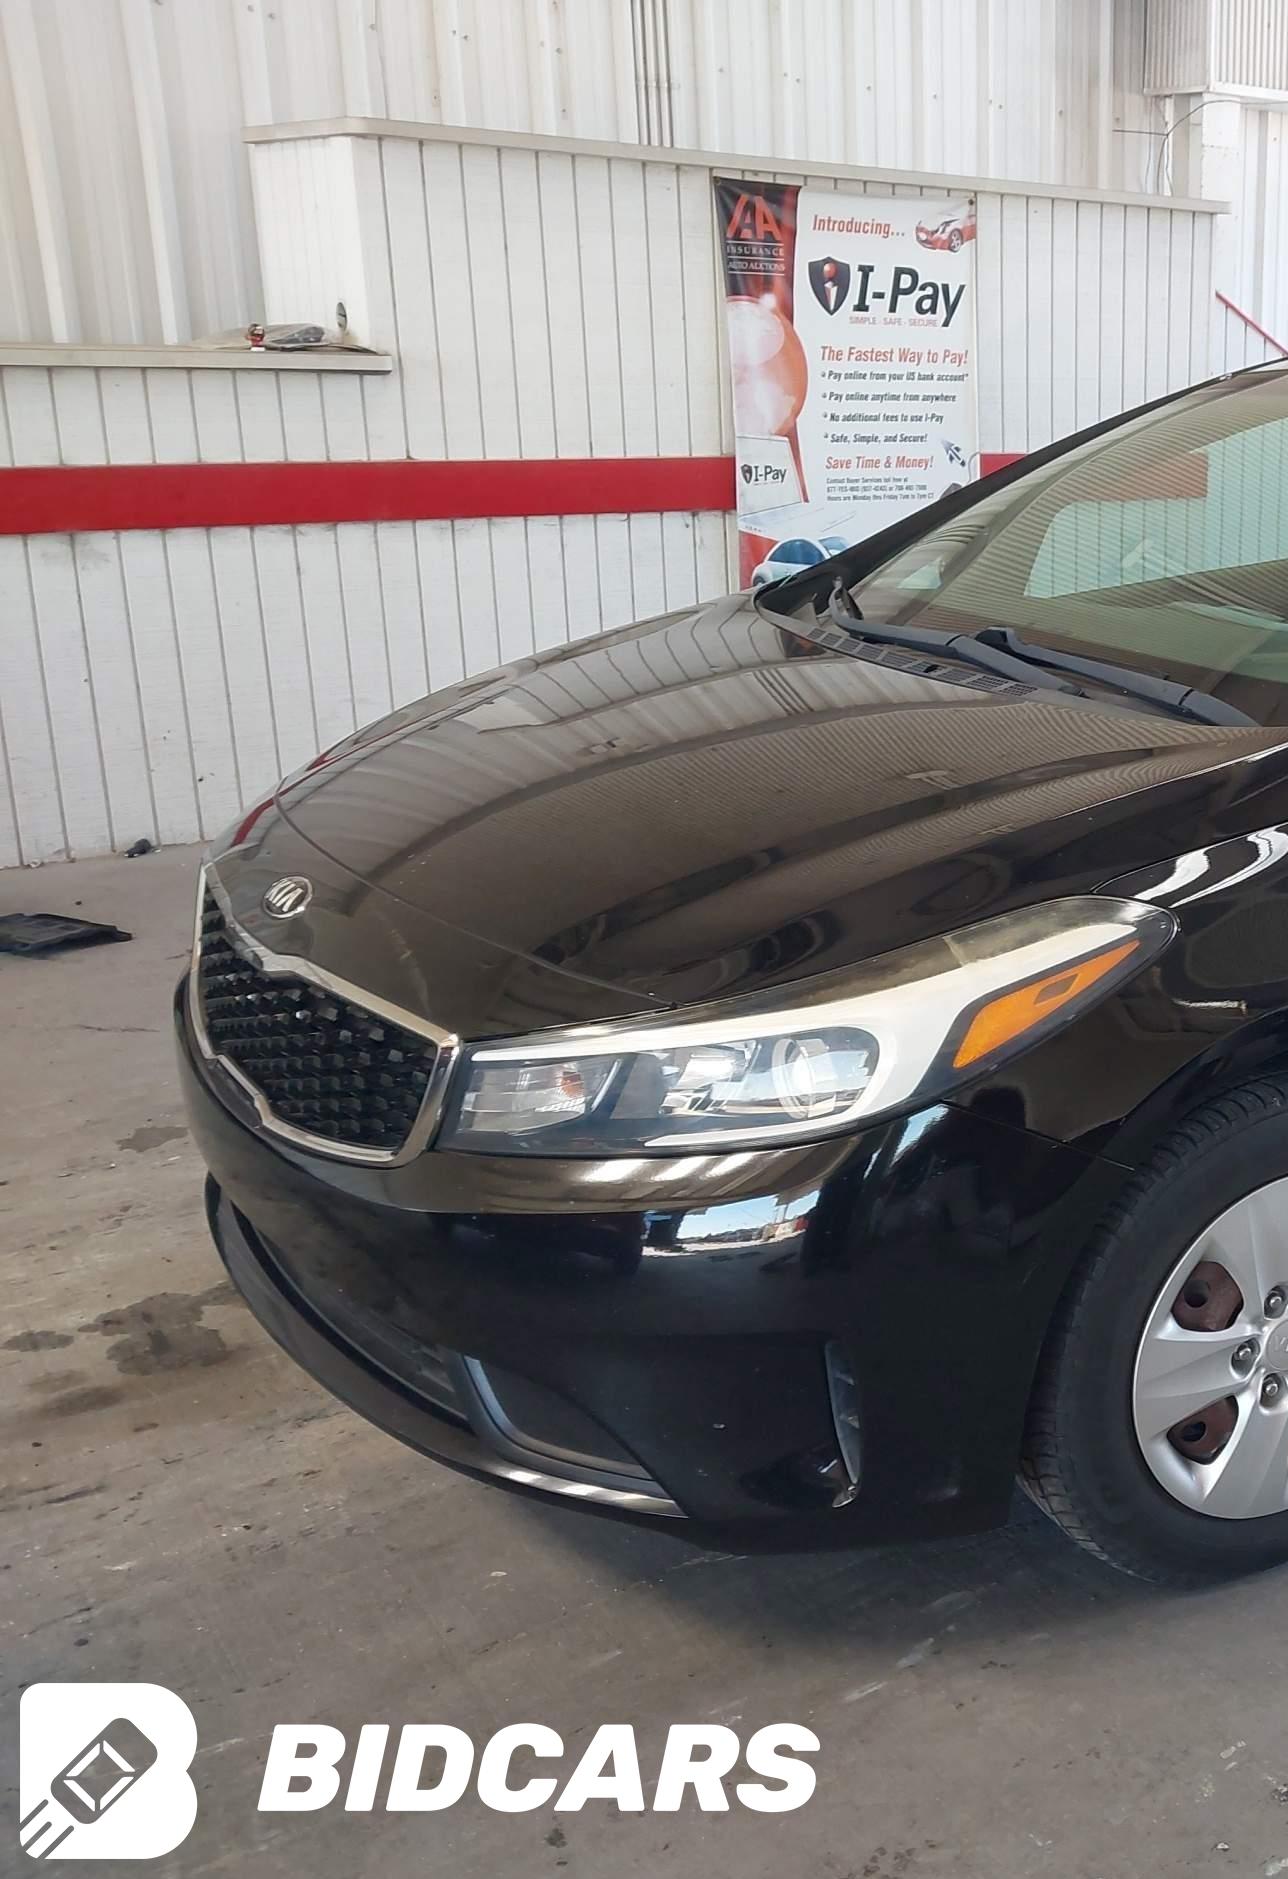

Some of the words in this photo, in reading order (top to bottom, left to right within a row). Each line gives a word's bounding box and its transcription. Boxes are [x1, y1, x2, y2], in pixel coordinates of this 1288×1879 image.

[812, 214, 905, 239] Introducing...
[726, 244, 784, 256] INSURANCE
[727, 261, 748, 270] AUTO
[748, 261, 786, 272] AUCTIONS
[852, 264, 967, 328] I-Pay
[820, 345, 843, 362] The
[847, 346, 894, 363] Fastest
[898, 347, 924, 367] Way
[926, 348, 939, 364] to
[942, 349, 969, 368] Pay!
[827, 370, 843, 383] Pay
[844, 370, 867, 381] online
[869, 371, 887, 381] from
[888, 373, 905, 383] your
[905, 372, 916, 381] US
[917, 372, 934, 382] bank
[828, 391, 843, 403] Pay
[845, 392, 869, 402] online
[871, 392, 901, 404] anytime
[903, 392, 921, 402] from
[921, 393, 957, 404] anywhere
[829, 412, 840, 422] No
[841, 412, 881, 423] additional
[882, 413, 899, 423] fees
[900, 413, 909, 422] to
[910, 414, 923, 423] use
[924, 412, 944, 424] I-Pay
[830, 433, 851, 444] Safe,
[853, 433, 881, 445] Simple,
[883, 433, 898, 443] and
[899, 433, 929, 443] Secure!
[825, 455, 852, 470] Save
[855, 455, 881, 469] Time
[884, 456, 892, 469] &
[895, 456, 934, 472] Money!
[753, 465, 787, 483] I-Pay
